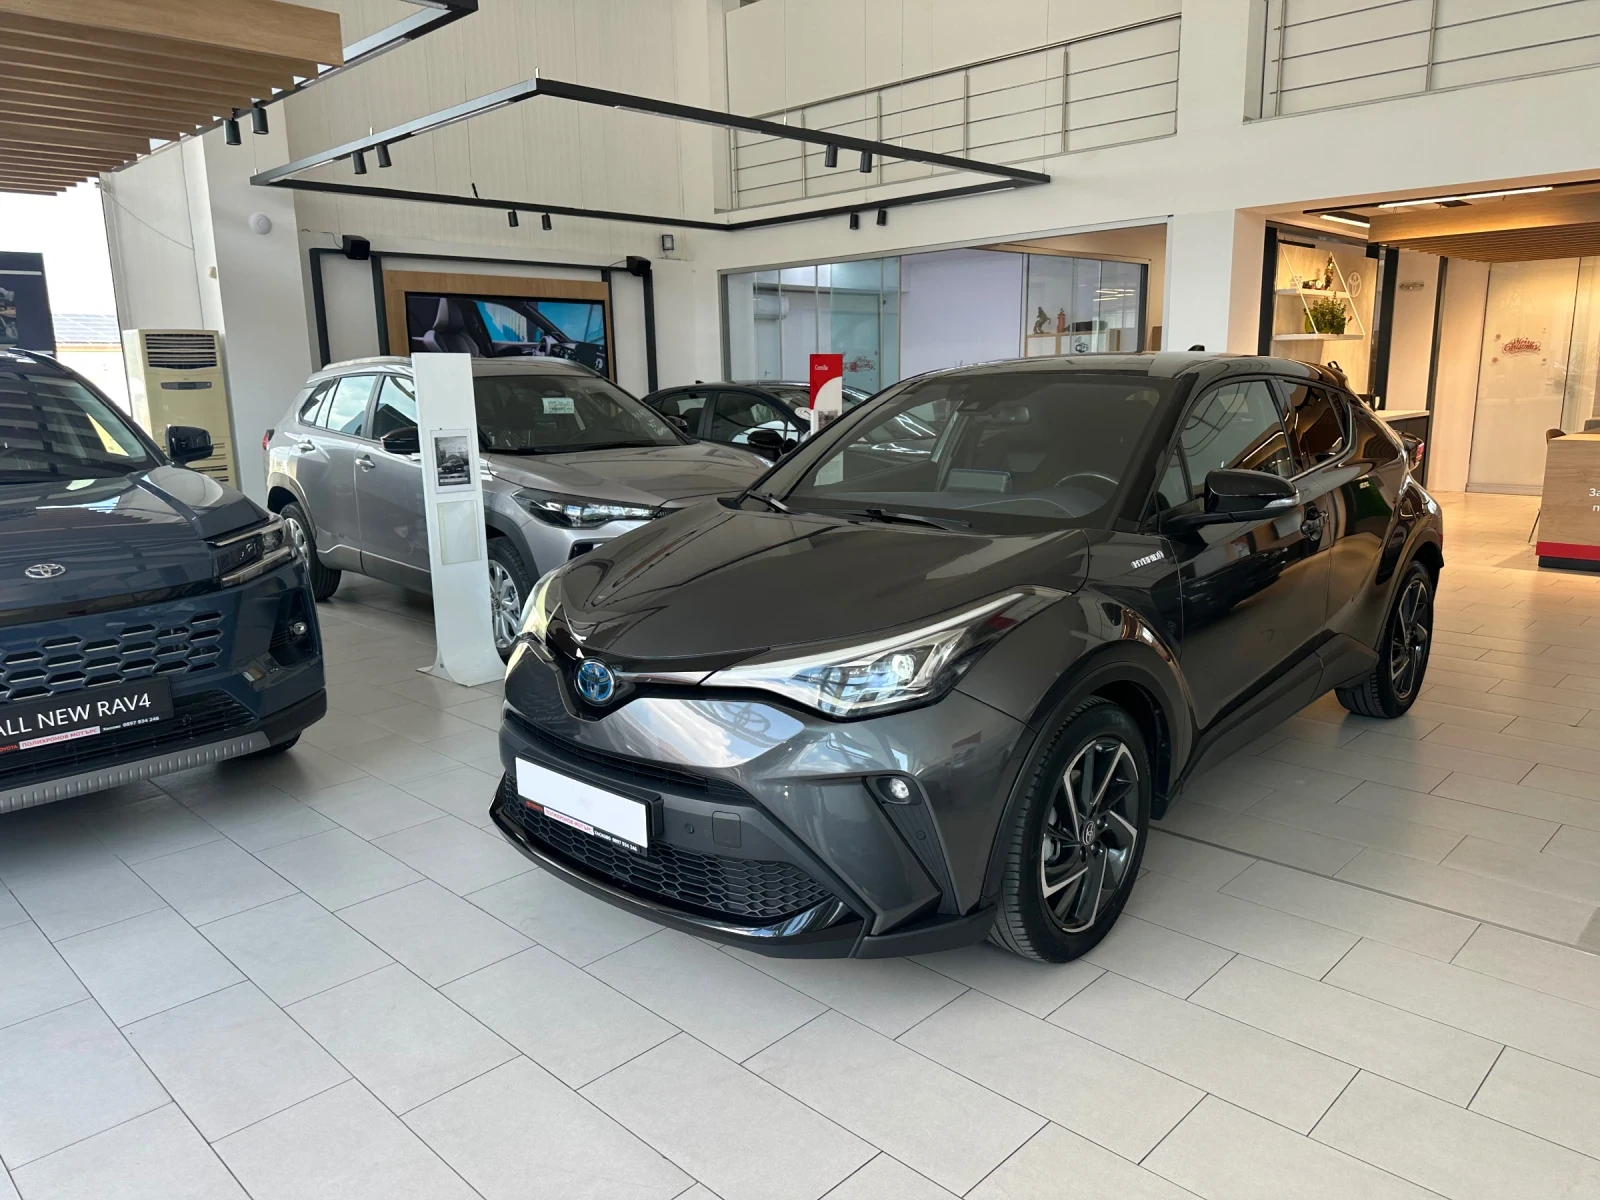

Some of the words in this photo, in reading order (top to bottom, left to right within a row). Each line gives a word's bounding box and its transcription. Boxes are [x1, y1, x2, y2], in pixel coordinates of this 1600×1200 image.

[37, 704, 91, 728] NEW
[97, 692, 152, 717] RAV4
[21, 734, 69, 748] ПОЛИХРОНОВ
[70, 728, 98, 738] МОТЪРС
